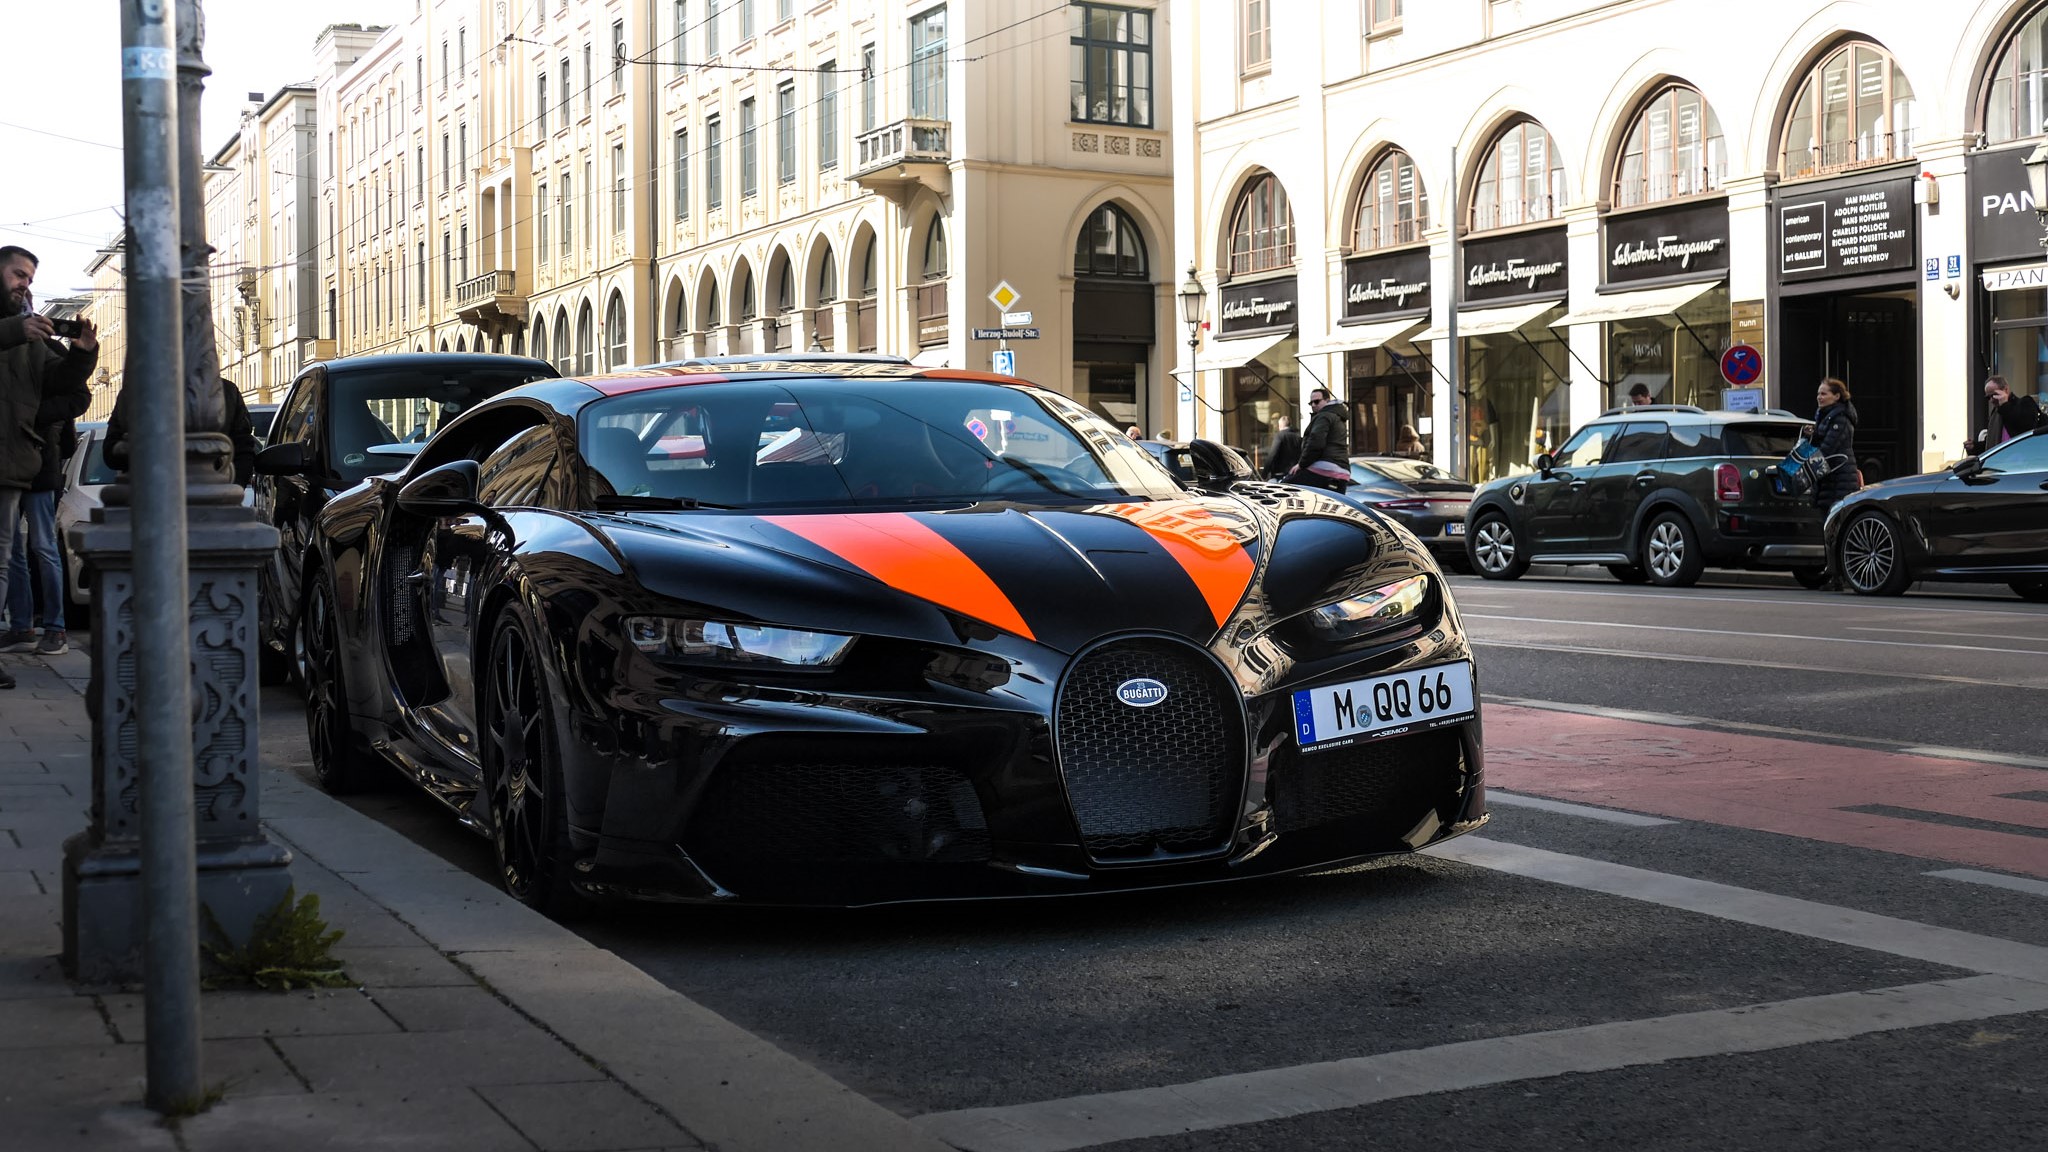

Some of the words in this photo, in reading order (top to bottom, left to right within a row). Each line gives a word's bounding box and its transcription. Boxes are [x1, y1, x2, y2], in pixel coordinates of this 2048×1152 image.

[1845, 196, 1858, 205] SAM
[1860, 192, 1884, 204] FRANCIS
[1834, 206, 1858, 216] ADOLPH
[1860, 202, 1887, 213] GOTTLIEB
[1785, 215, 1810, 226] american
[1842, 216, 1858, 226] HANS
[1859, 212, 1889, 223] HOFMANN
[1832, 226, 1858, 237] CHARLES
[1860, 222, 1887, 233] POLLOCK
[1785, 232, 1822, 244] contemporary
[1832, 236, 1858, 247] RICHARD
[1859, 230, 1906, 243] POUSETTE-DART
[1612, 240, 1657, 265] Salvatore
[1657, 235, 1720, 268] Ferragamo
[1786, 253, 1794, 262] art
[1794, 250, 1822, 260] GALLERY
[1840, 246, 1858, 256] DAVID
[1860, 244, 1877, 254] SMITH
[1843, 256, 1858, 266] JACK
[1860, 252, 1889, 263] TWORKOV
[1927, 259, 1938, 270] 29
[1949, 256, 1958, 269] 31
[1468, 263, 1507, 286] Salvatore
[1507, 258, 1562, 289] Ferragamo
[1998, 268, 2044, 288] PAN
[1348, 282, 1381, 303] Salvatore
[1380, 278, 1427, 307] Ferragamo
[1222, 301, 1251, 320] Salvatore
[1251, 298, 1291, 323] Ferragamo
[978, 329, 1037, 339] Herzog-Rudolf-Str.
[1123, 688, 1162, 699] BUGATTI
[1333, 688, 1356, 730] M
[1373, 678, 1412, 722] QQ
[1418, 672, 1451, 714] 66
[1302, 723, 1310, 736] D
[1380, 726, 1409, 737] SEMCO
